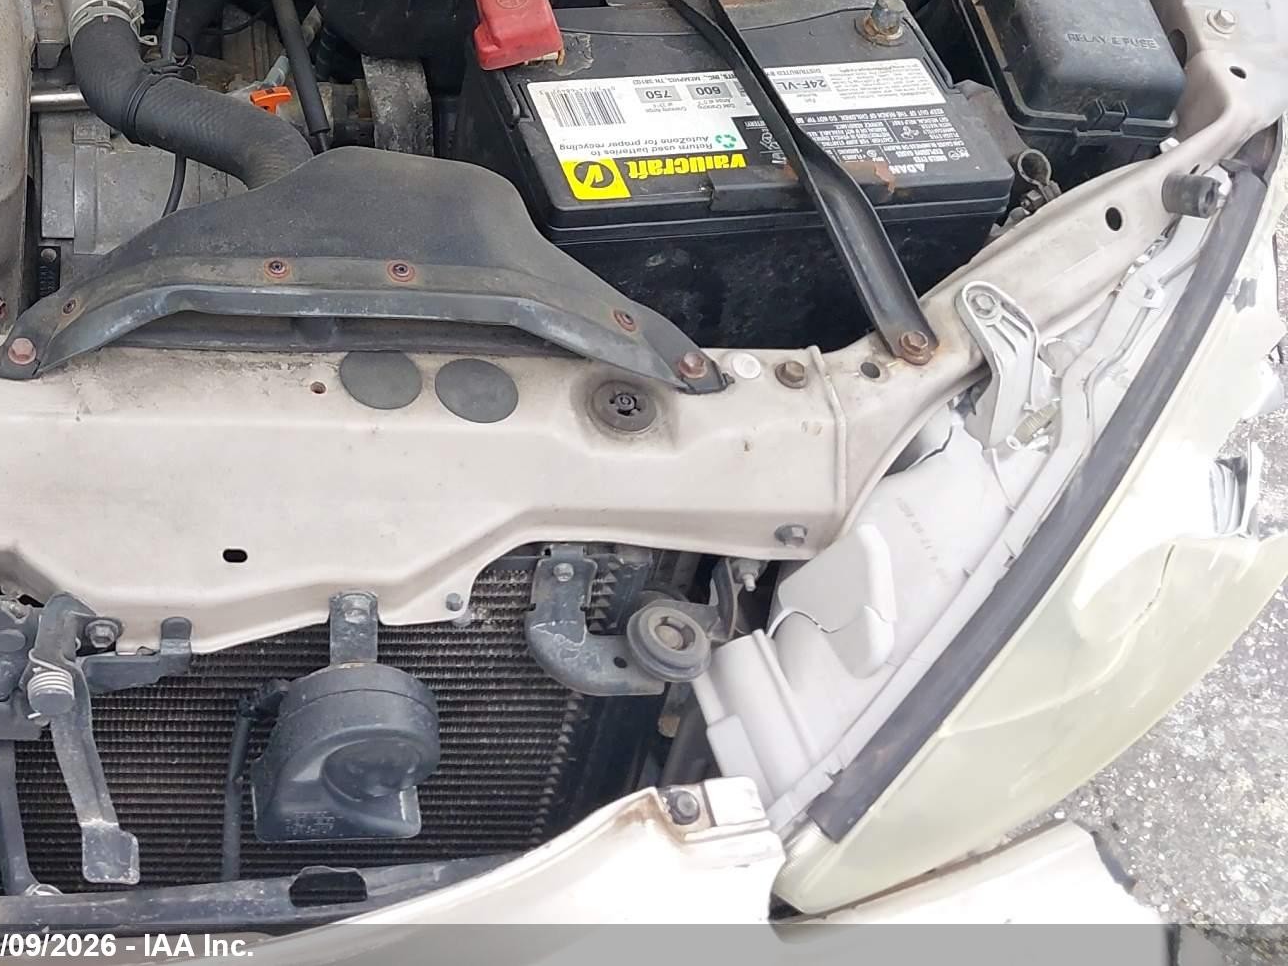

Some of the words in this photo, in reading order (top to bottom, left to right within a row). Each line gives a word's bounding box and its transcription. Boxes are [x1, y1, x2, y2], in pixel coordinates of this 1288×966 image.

[1065, 32, 1107, 44] RELAY
[1122, 37, 1160, 49] FUSE
[774, 79, 828, 90] 24F-VL
[643, 89, 672, 99] 750
[693, 85, 722, 95] 600
[605, 139, 642, 147] proper
[659, 135, 710, 144] AutoZone
[557, 141, 605, 151] recycling
[603, 147, 649, 155] batteries
